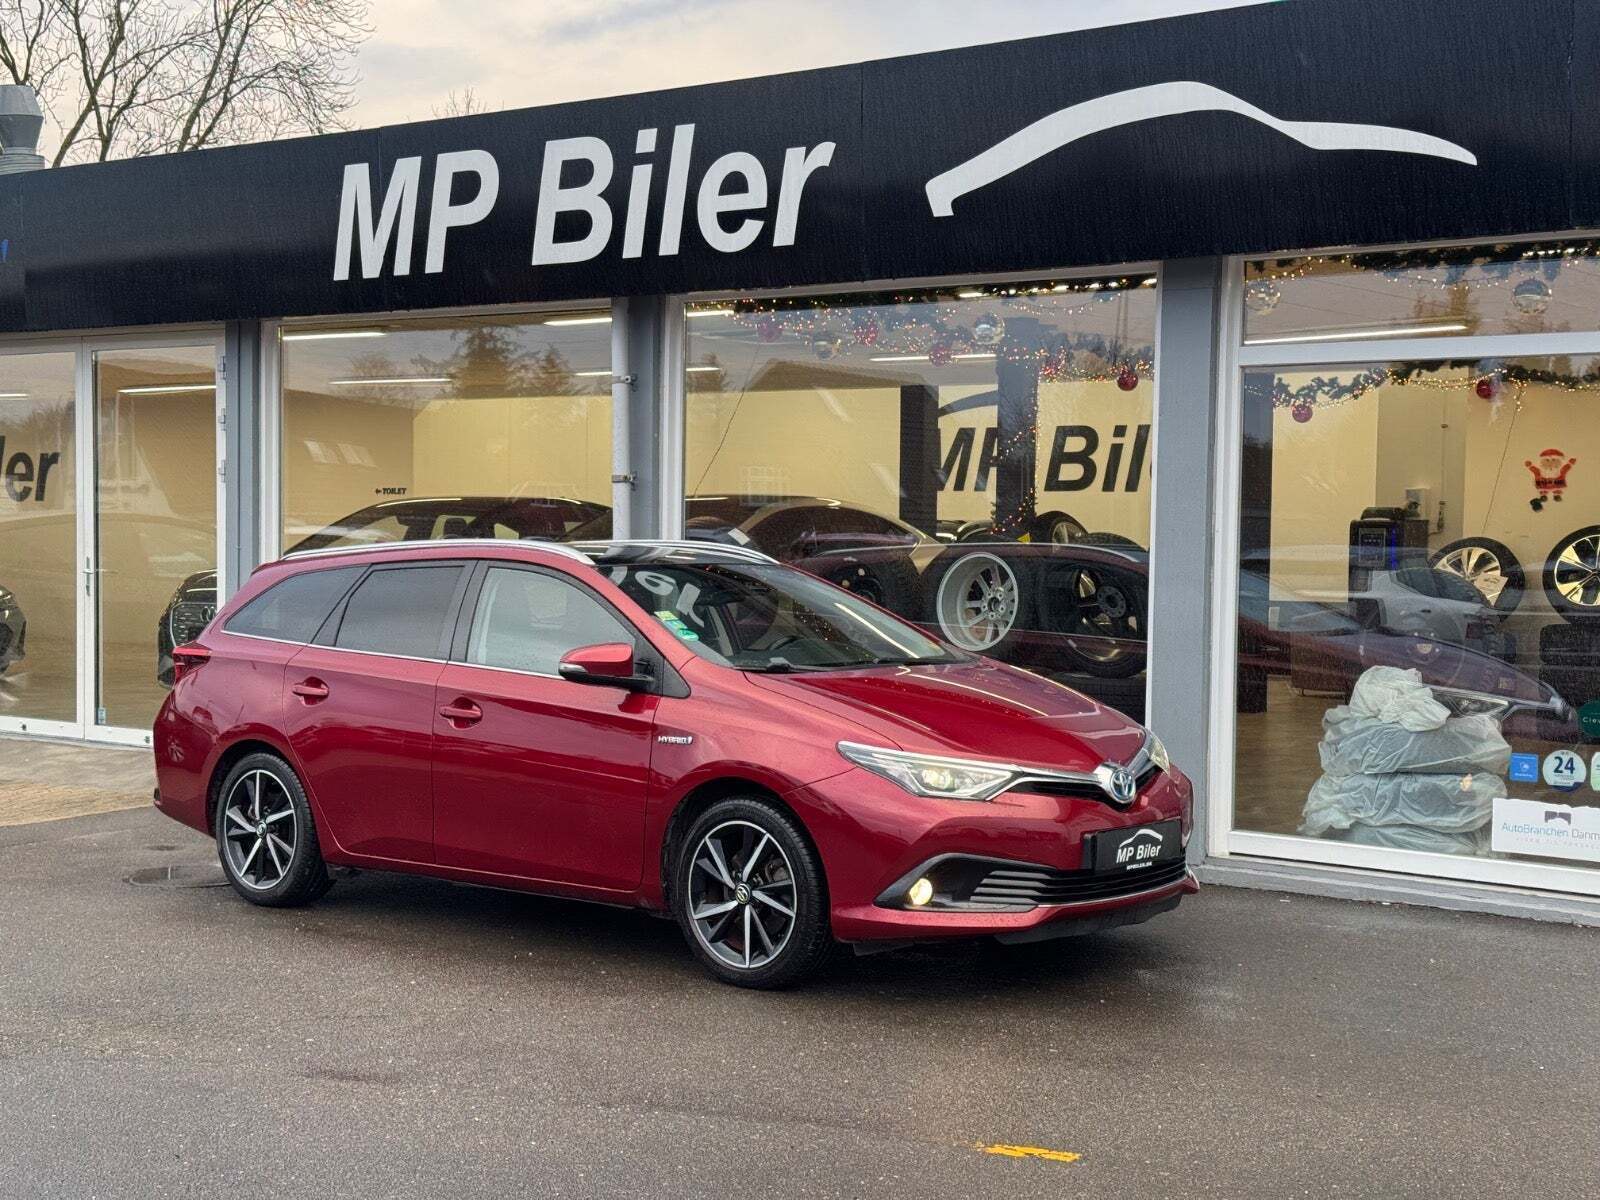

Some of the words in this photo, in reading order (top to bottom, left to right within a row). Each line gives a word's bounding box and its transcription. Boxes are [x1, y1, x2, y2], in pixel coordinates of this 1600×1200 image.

[333, 149, 500, 281] MP
[531, 123, 836, 266] Biler
[1043, 424, 1152, 492] Bil
[0, 436, 61, 502] er
[382, 487, 407, 495] TOILET
[1553, 756, 1576, 775] 24
[1502, 822, 1568, 837] AutoBranchen
[1571, 828, 1600, 841] Danm
[1116, 847, 1135, 863] MP
[1136, 844, 1161, 860] Biler
